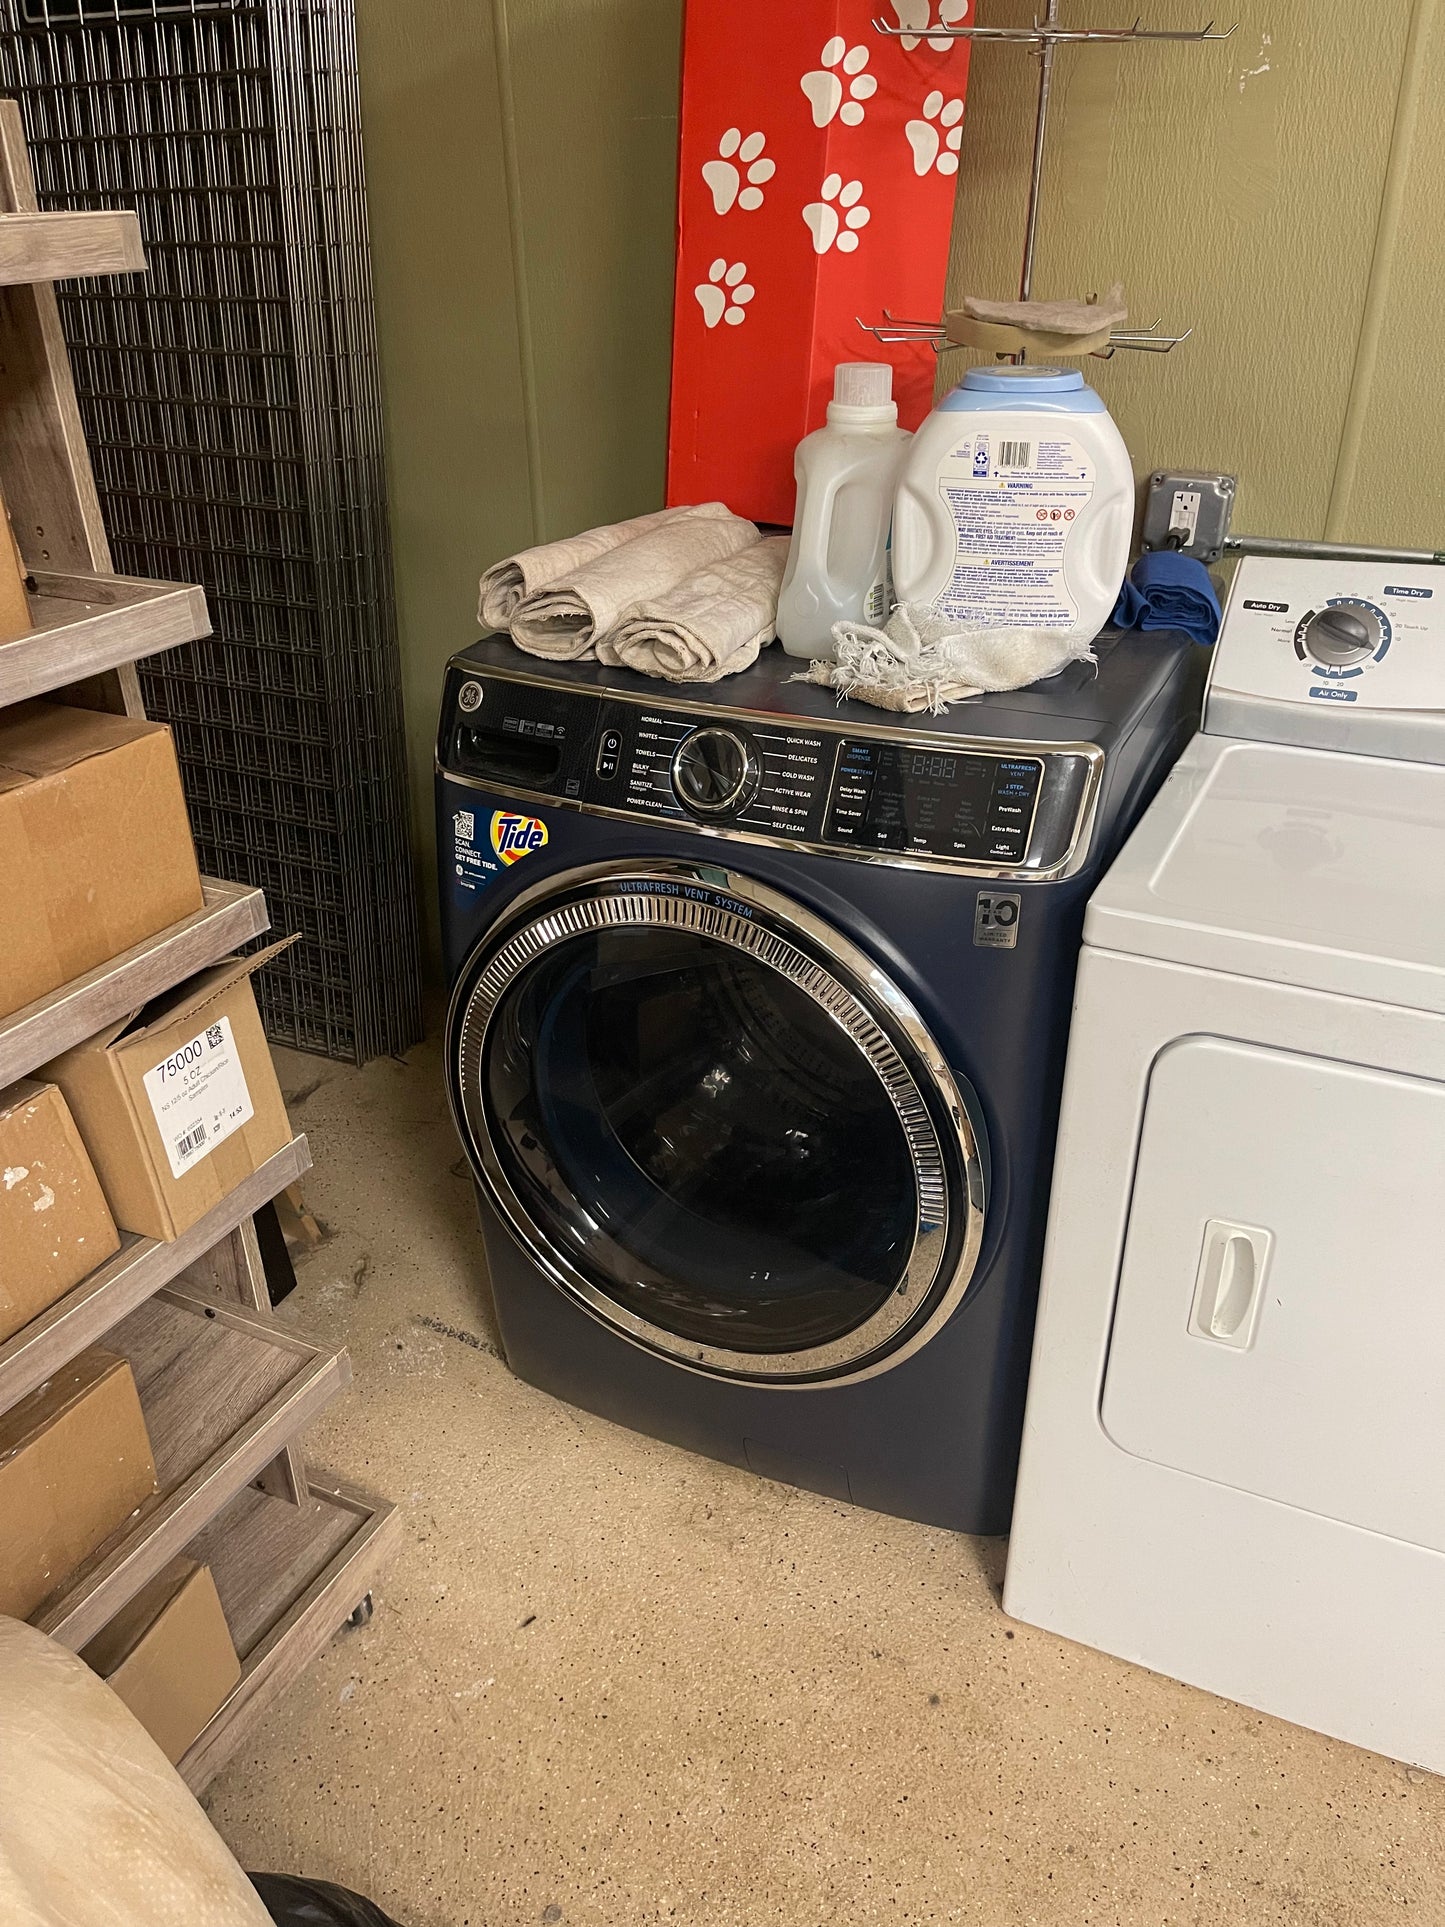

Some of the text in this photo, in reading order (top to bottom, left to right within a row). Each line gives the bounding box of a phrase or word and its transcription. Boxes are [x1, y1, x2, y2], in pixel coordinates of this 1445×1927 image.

[990, 559, 1035, 567] AVERTISSEMENT
[1392, 587, 1424, 597] Time Dry
[1268, 603, 1281, 612] Dry
[1318, 690, 1349, 700] Air Only
[640, 715, 663, 725] NORMAL
[638, 731, 659, 740] WHITES
[786, 736, 822, 748] QUICK WASH
[635, 748, 657, 758] TOWELS
[851, 747, 870, 755] SMART
[787, 753, 818, 765] DELICATES
[846, 753, 872, 762] DISPENSE
[632, 762, 650, 771] BULKY
[1000, 763, 1037, 771] ULTRAFRESH
[781, 771, 815, 782] COLD WASH
[629, 779, 653, 789] SANITIZE
[774, 786, 812, 799] ACTIVE WEAR
[839, 785, 853, 794] Delay
[626, 796, 663, 809] POWER CLEAN
[771, 804, 789, 814] RINSE
[794, 808, 809, 817] SPIN
[847, 809, 862, 817] Saver
[771, 821, 806, 833] SELF CLEAN
[837, 826, 854, 835] Sound
[498, 817, 544, 853] Tide
[913, 836, 927, 844] Temp
[454, 845, 482, 859] CONNECT.
[995, 843, 1010, 851] Light
[455, 853, 498, 871] GET FREE TIDE.
[619, 881, 753, 917] ULTRAFRESH VENT SYSTEM
[978, 898, 1018, 926] 10
[157, 1040, 203, 1083] 75000
[183, 1066, 202, 1085] 5 OZ
